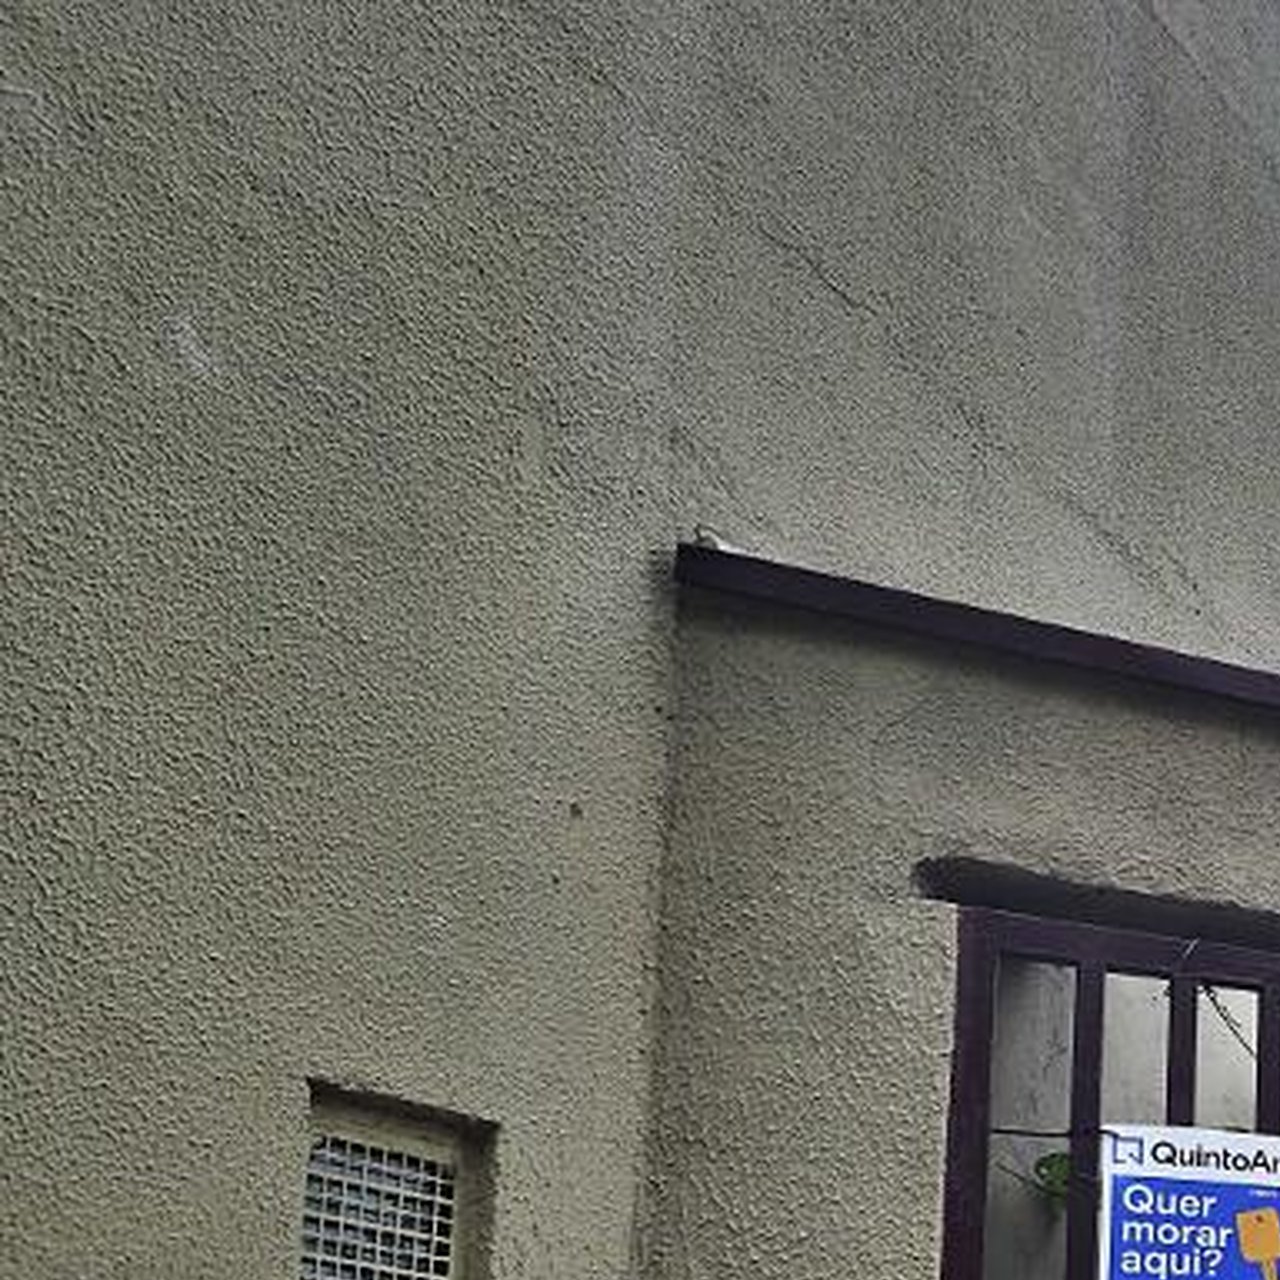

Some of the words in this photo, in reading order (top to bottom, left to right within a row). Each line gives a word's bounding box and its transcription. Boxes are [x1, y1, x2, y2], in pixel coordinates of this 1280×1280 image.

[1122, 1184, 1218, 1218] Quer
[1121, 1220, 1234, 1249] morar
[1120, 1249, 1223, 1280] aqui?
